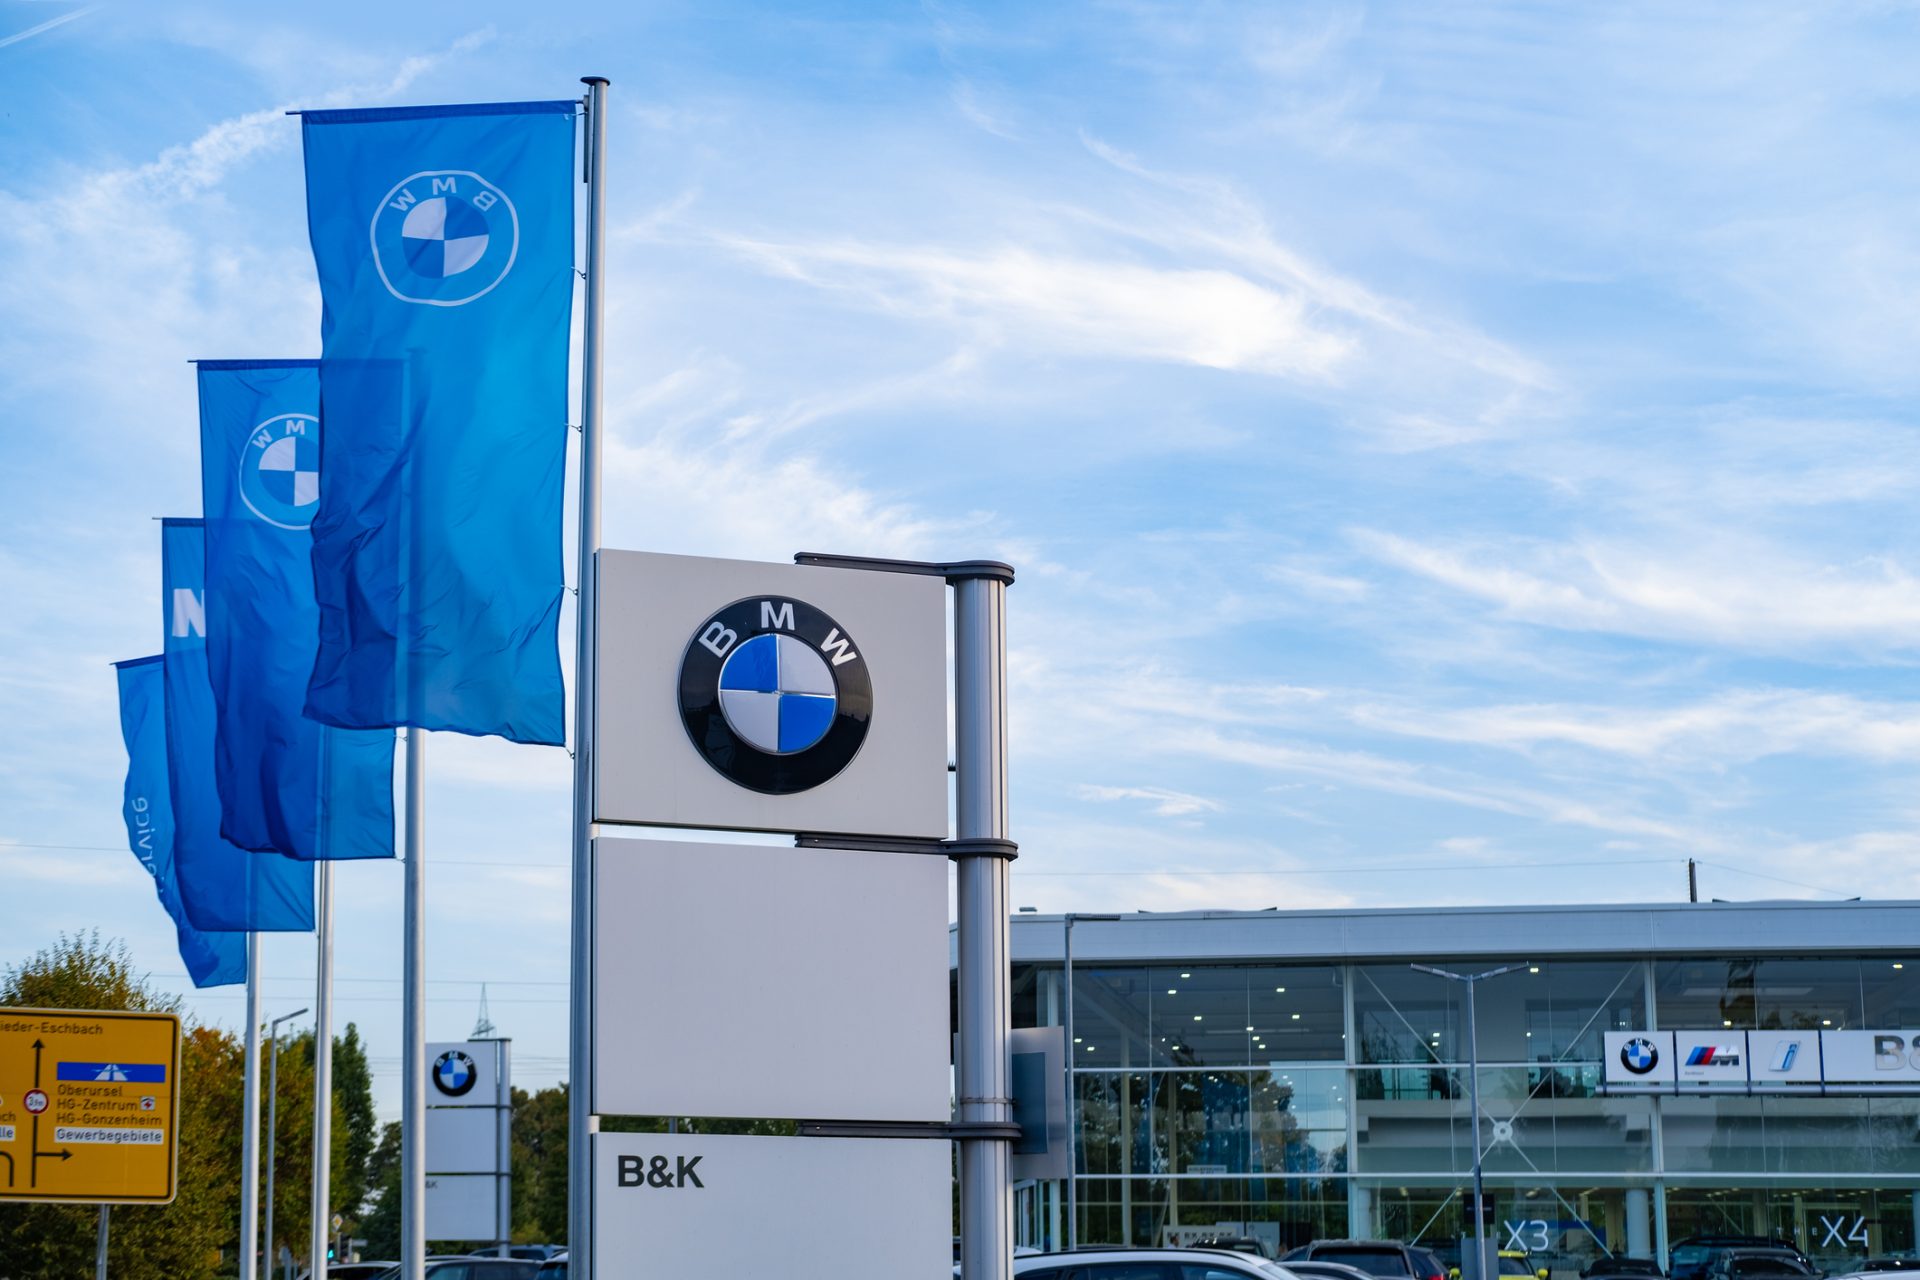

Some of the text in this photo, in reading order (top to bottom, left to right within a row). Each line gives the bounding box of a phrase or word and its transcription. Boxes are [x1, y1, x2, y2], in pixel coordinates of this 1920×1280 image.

[699, 601, 858, 667] BMW
[0, 1022, 103, 1034] ieder-Eschbach
[57, 1084, 123, 1097] Oberursel
[56, 1098, 138, 1111] HG-Zentrum
[0, 1111, 16, 1122] ch
[56, 1113, 162, 1126] HG-Gonzenheim
[0, 1126, 14, 1138] lle
[56, 1128, 162, 1144] Gewerbegebiete
[617, 1155, 705, 1188] B&K
[1504, 1220, 1549, 1251] X3
[1821, 1215, 1869, 1248] X4
